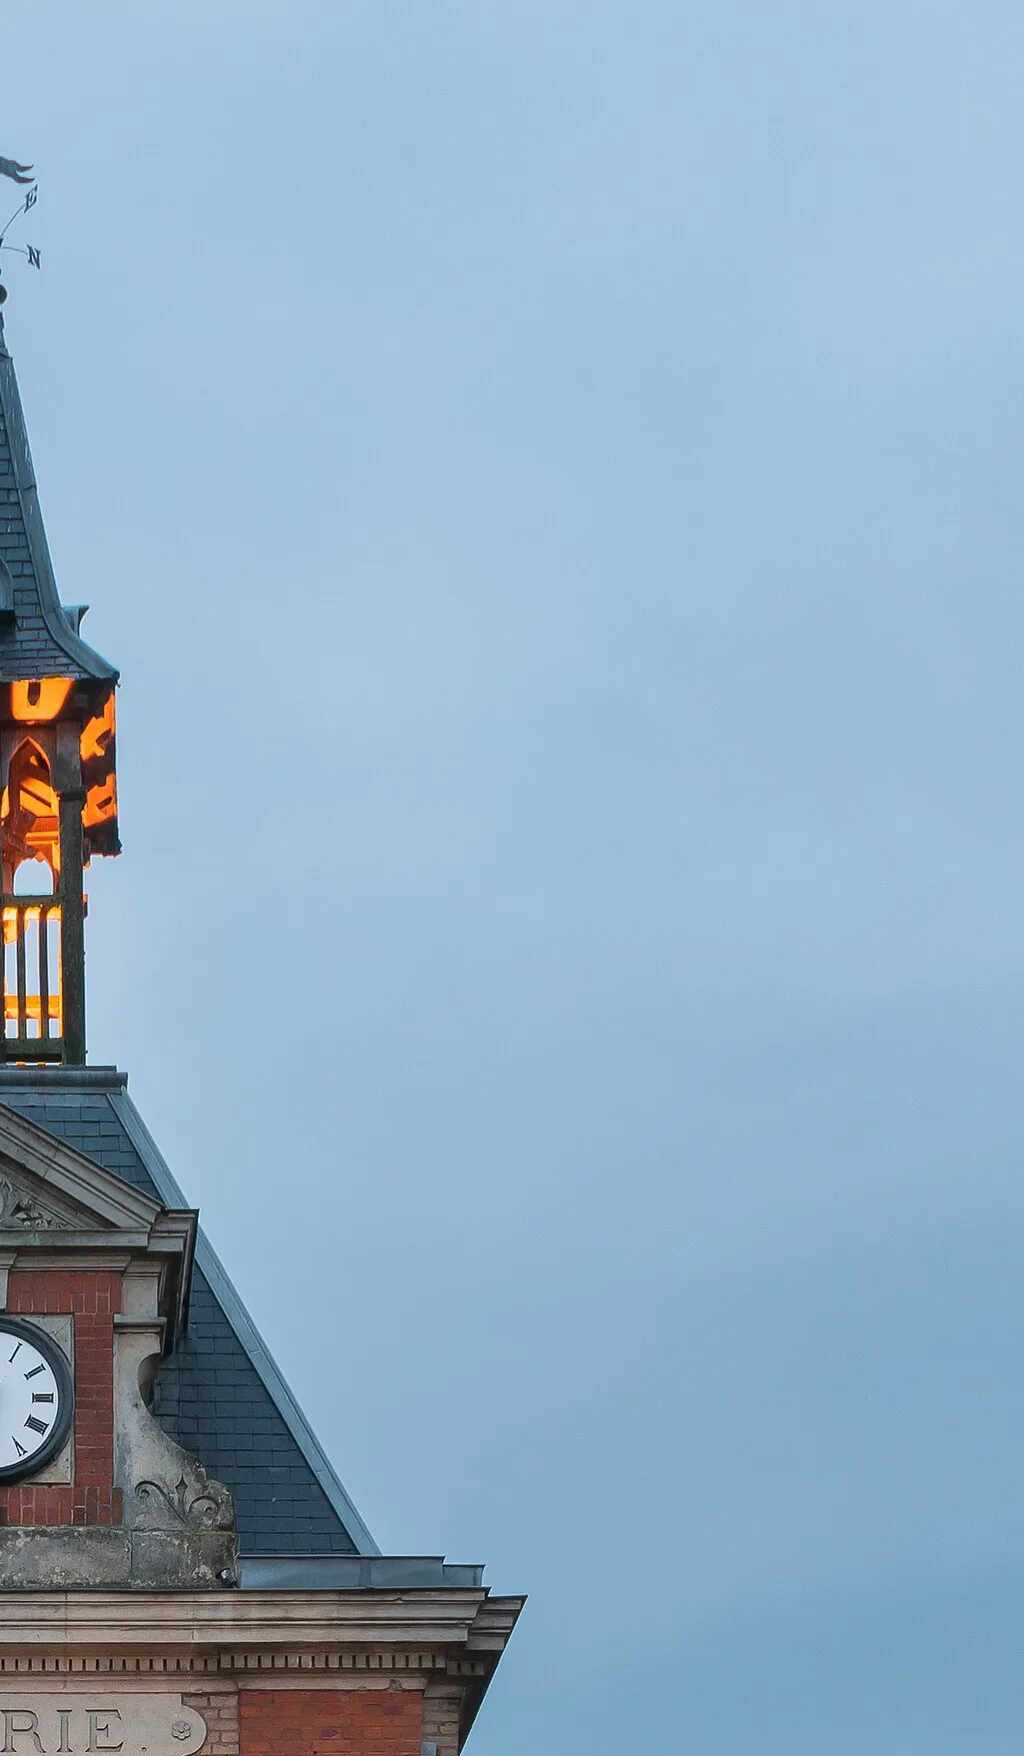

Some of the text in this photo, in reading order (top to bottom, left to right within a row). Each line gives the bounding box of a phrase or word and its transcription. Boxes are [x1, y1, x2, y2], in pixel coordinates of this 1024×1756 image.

[26, 244, 41, 270] N
[8, 1342, 23, 1363] I
[23, 1363, 46, 1381] II
[32, 1392, 54, 1404] III
[11, 1435, 28, 1457] V
